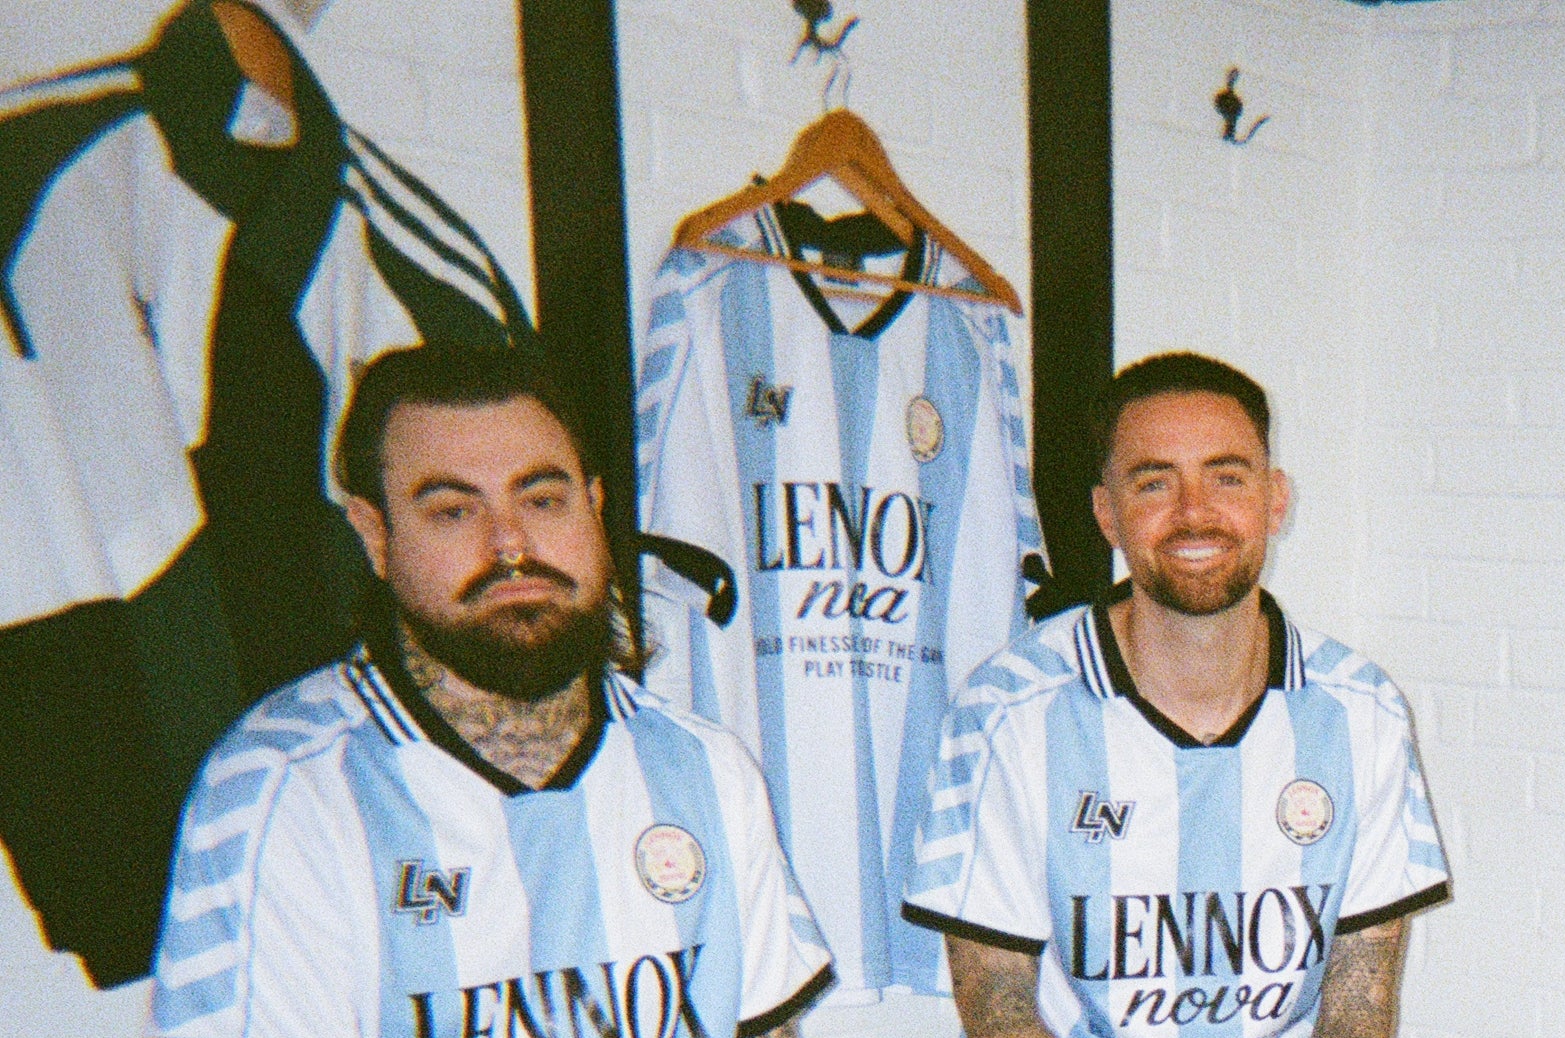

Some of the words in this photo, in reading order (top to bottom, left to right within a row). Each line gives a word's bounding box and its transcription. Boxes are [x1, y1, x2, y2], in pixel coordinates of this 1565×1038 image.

[804, 659, 845, 678] PLAY
[887, 640, 915, 661] THE
[1069, 789, 1136, 844] LN
[393, 859, 471, 925] LN
[1069, 883, 1337, 982] LENNOX
[1119, 981, 1295, 1029] nova
